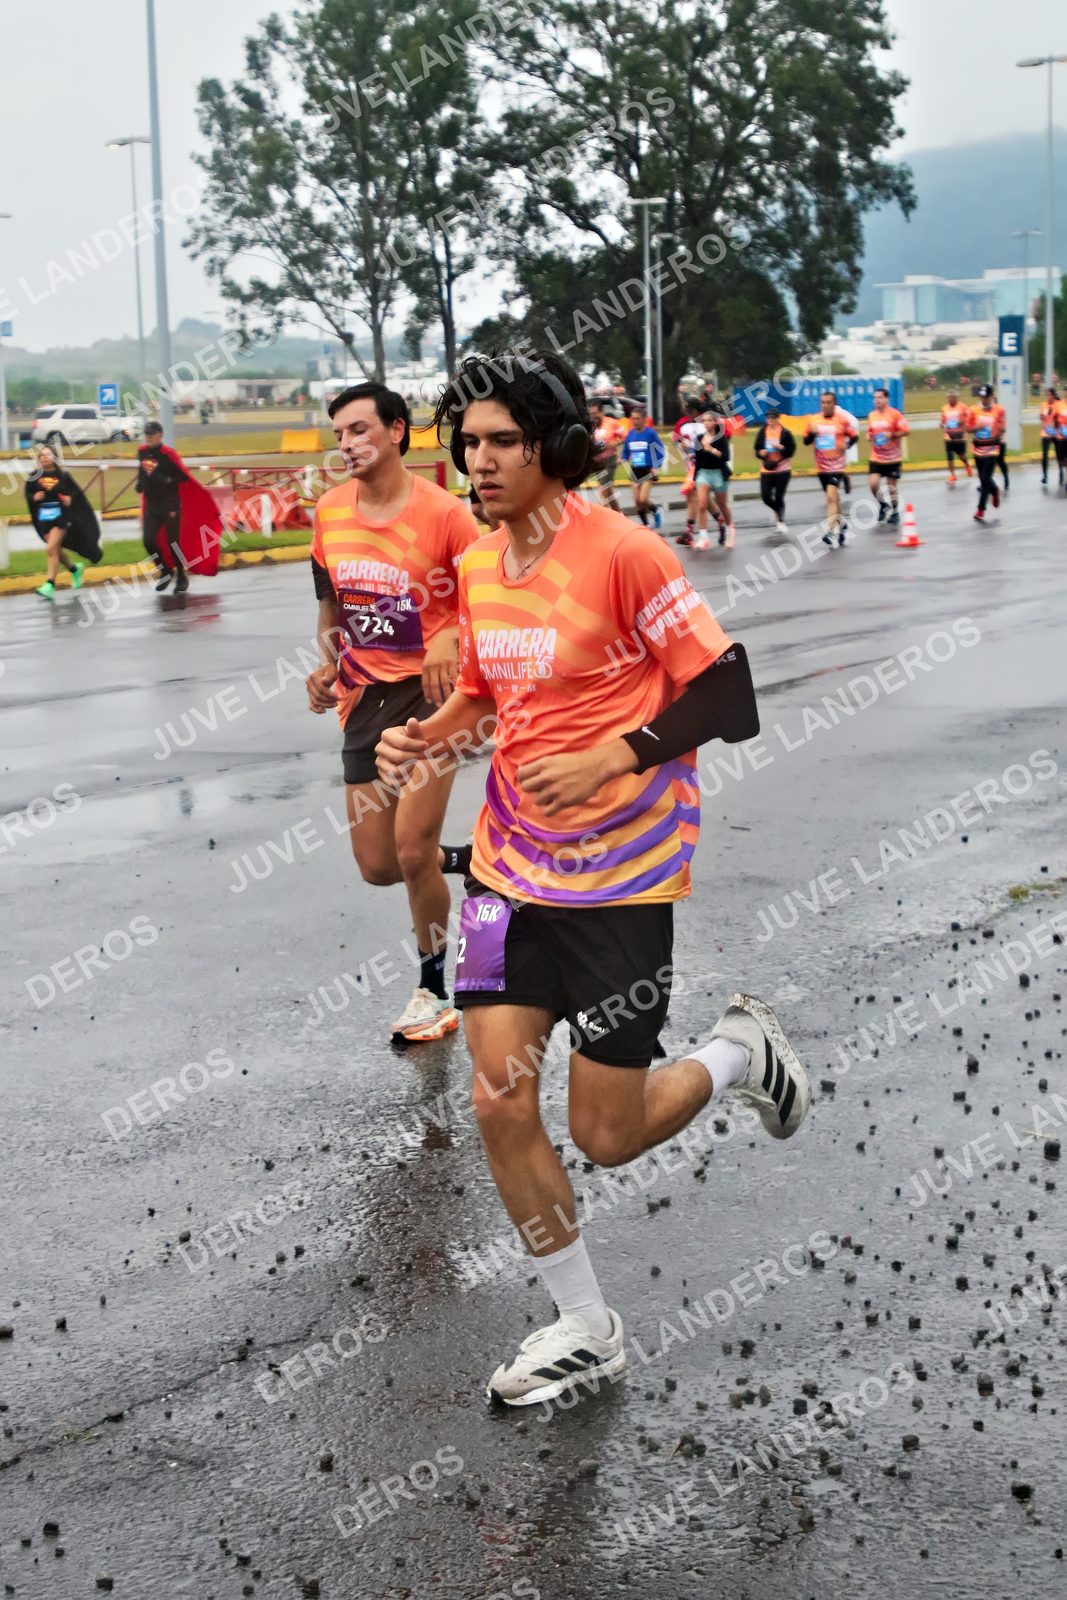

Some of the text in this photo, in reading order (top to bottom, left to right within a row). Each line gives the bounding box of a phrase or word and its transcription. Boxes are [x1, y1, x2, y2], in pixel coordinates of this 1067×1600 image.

[1002, 332, 1018, 353] E
[337, 561, 410, 590] CARRERA
[359, 616, 395, 636] 724
[477, 627, 557, 659] CARRERA
[456, 937, 467, 964] 2
